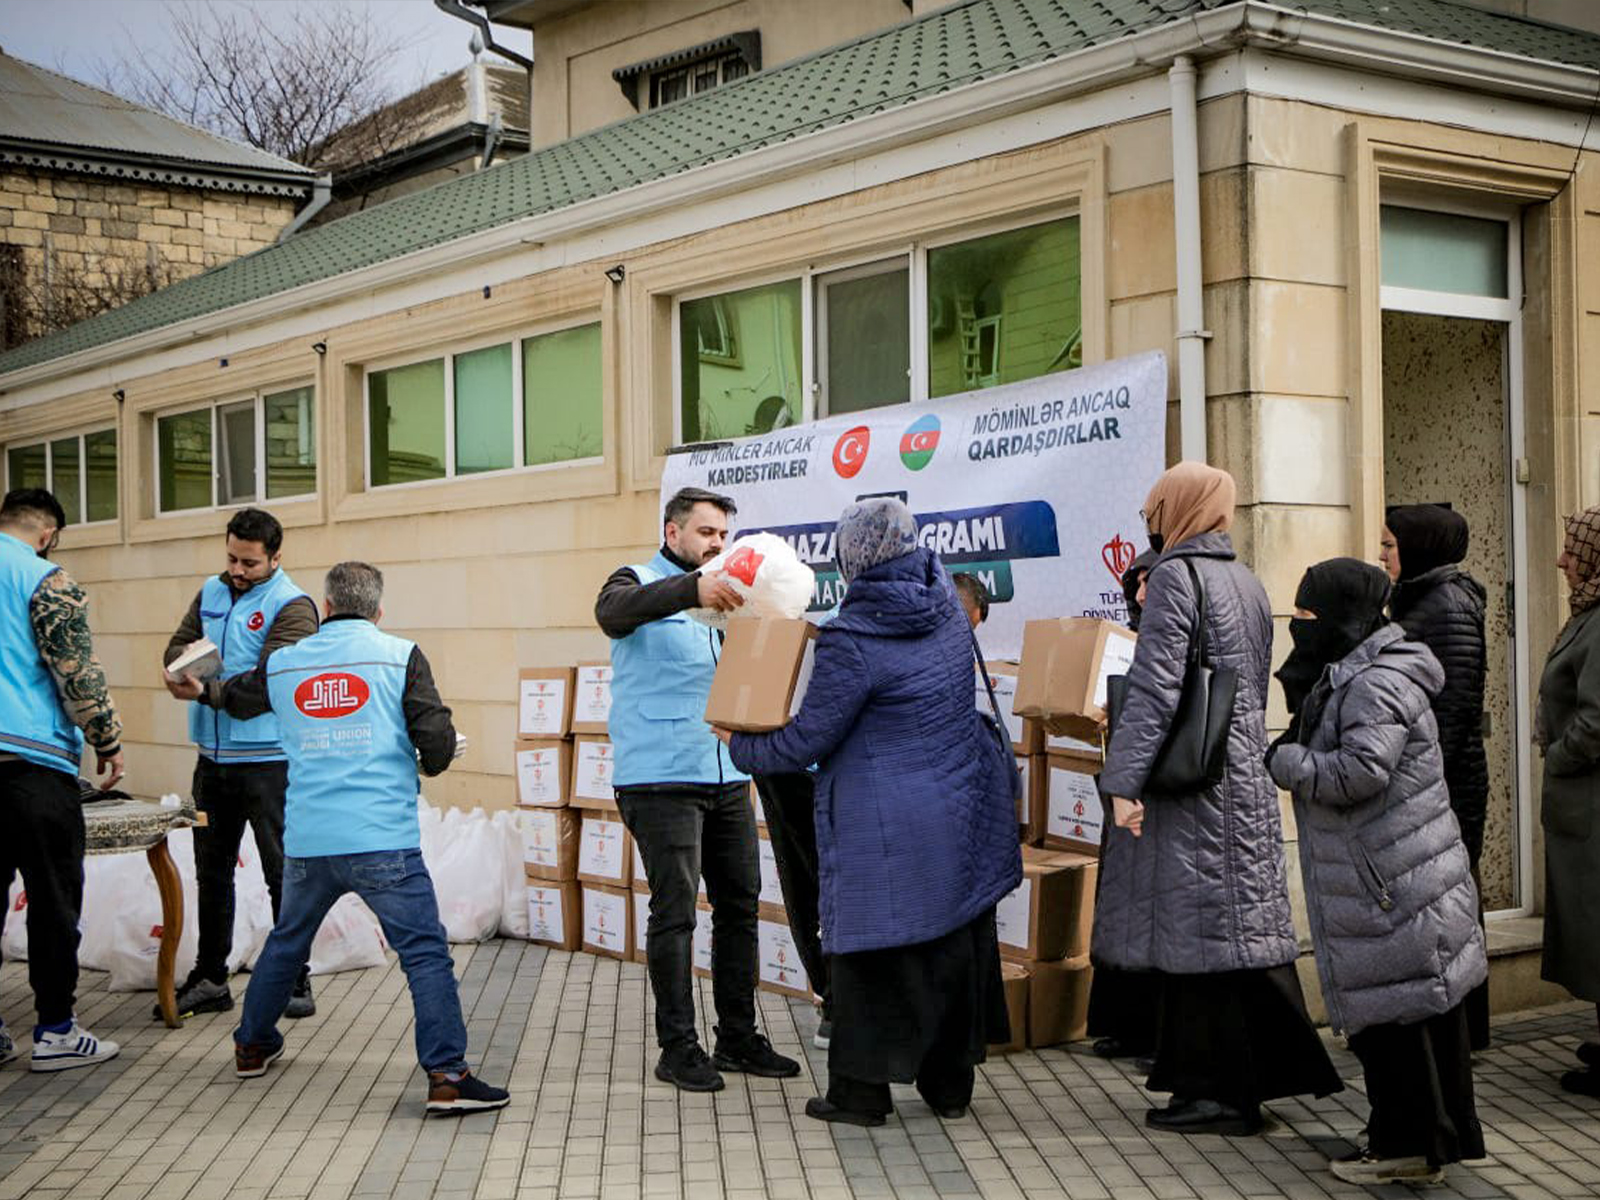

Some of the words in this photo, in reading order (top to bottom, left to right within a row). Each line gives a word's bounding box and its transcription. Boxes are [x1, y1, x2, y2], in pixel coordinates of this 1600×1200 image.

[973, 401, 1063, 435] MÖMİNLƏR
[1067, 386, 1131, 419] ANCAQ
[763, 436, 815, 458] ANCAK
[968, 417, 1121, 462] QARDAŞDIRLAR
[918, 516, 1006, 555] GRAMI
[1099, 589, 1125, 605] TÜR
